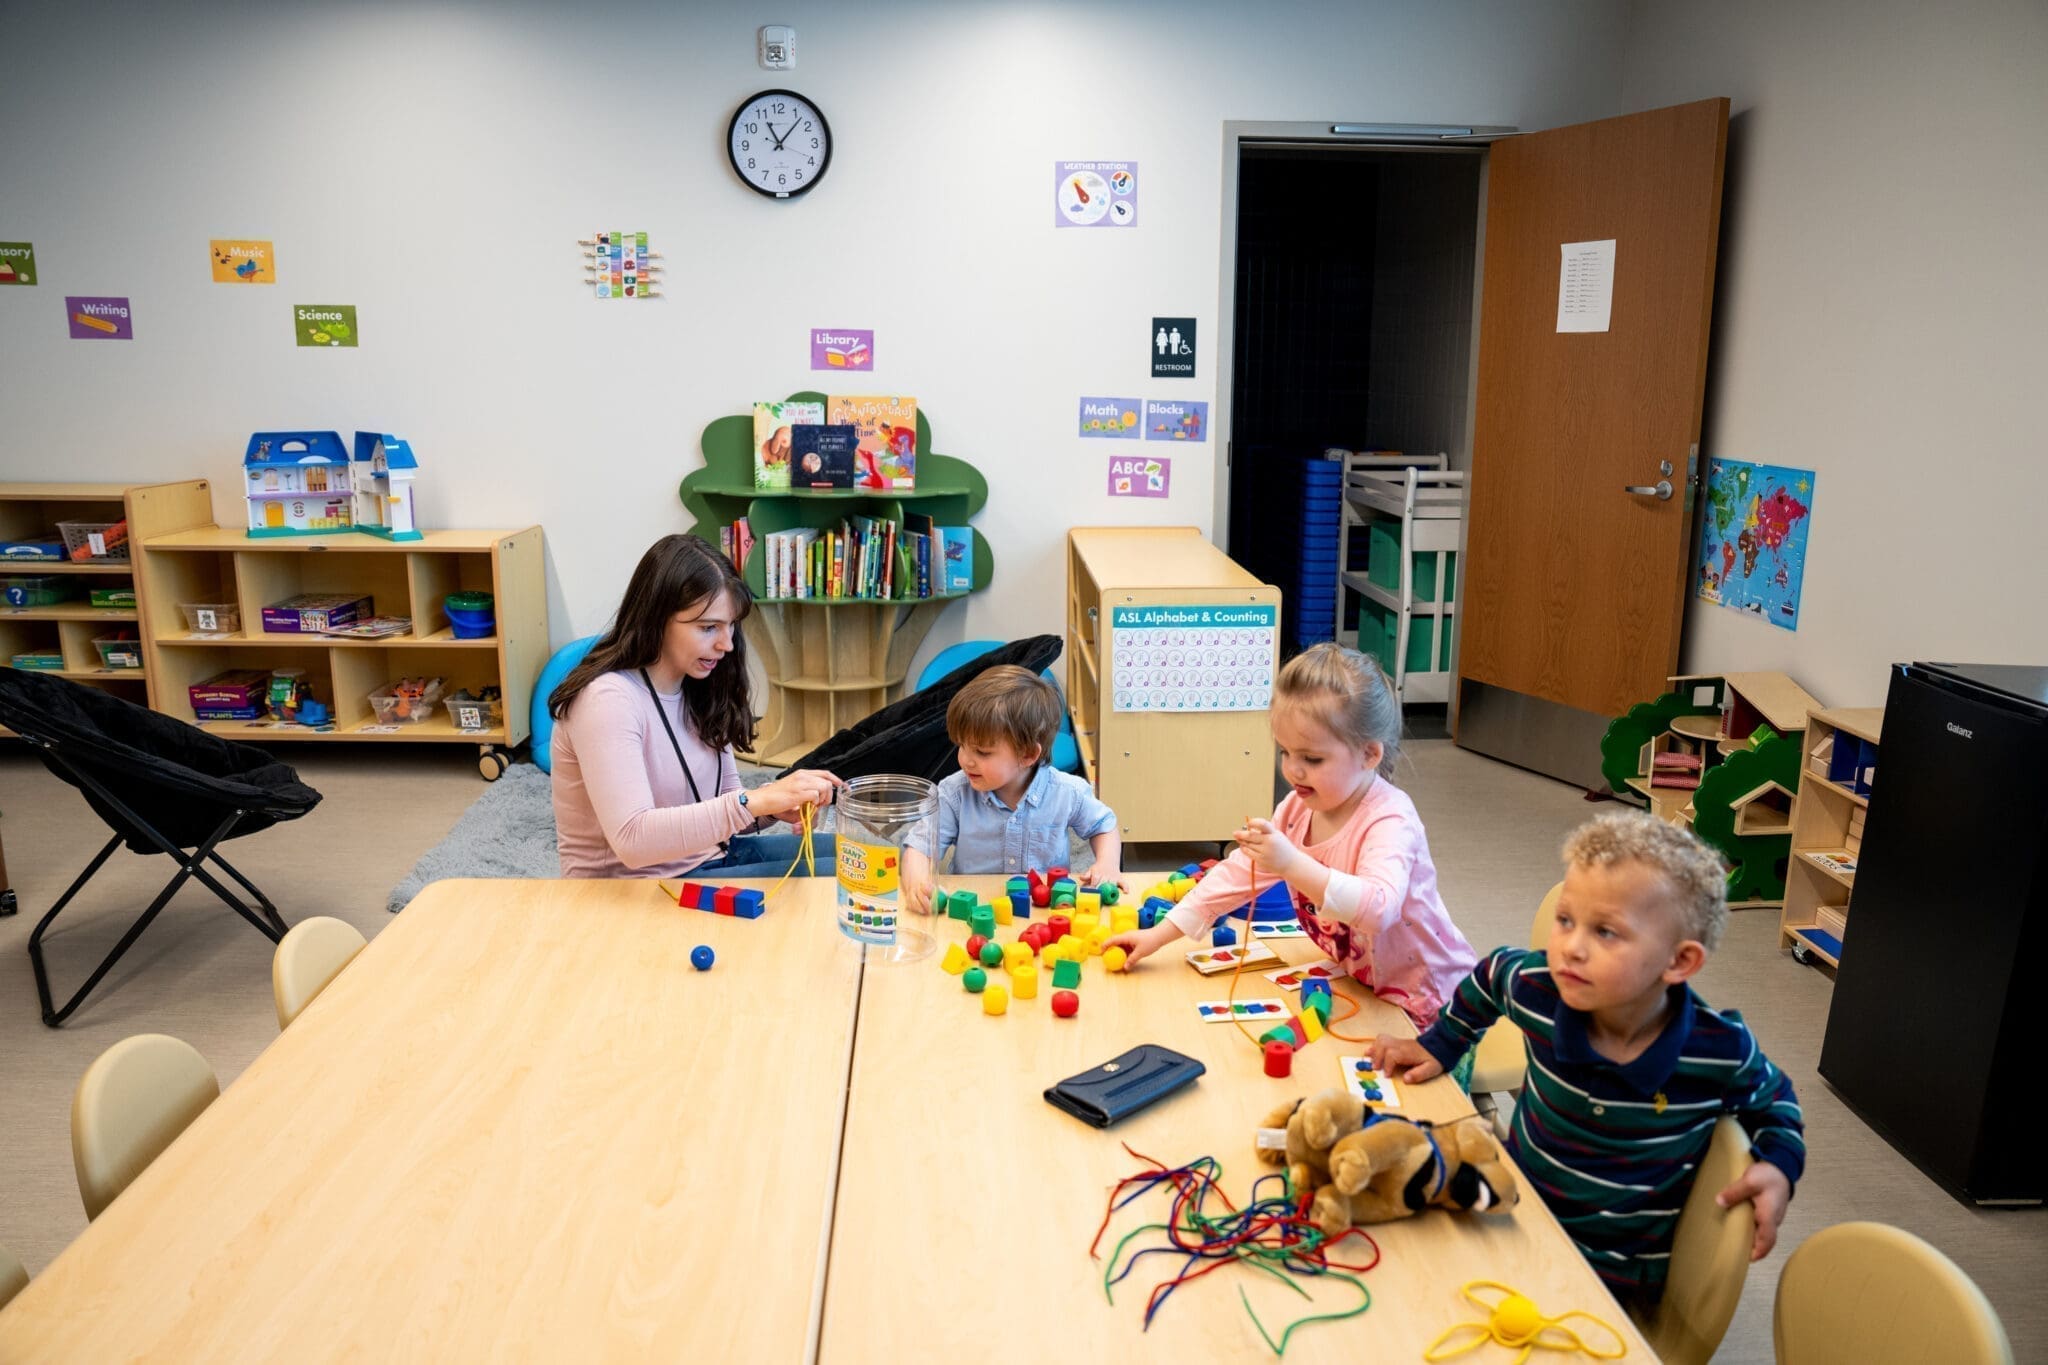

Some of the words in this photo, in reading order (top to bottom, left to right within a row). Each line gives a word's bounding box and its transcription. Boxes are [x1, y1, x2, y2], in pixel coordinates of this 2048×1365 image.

[756, 109, 768, 119] 11
[771, 103, 785, 114] 12
[792, 107, 798, 118] 1
[744, 123, 758, 134] 10
[804, 121, 812, 132] 2
[741, 140, 750, 151] 9
[810, 138, 819, 149] 3
[747, 158, 756, 168] 8
[807, 156, 815, 167] 4
[1064, 162, 1095, 170] WEATHER
[1097, 162, 1128, 170] STATION
[761, 171, 769, 181] 7
[778, 174, 786, 184] 6
[795, 169, 803, 180] 5
[230, 246, 264, 258] Music
[82, 303, 128, 318] Writing
[298, 309, 343, 321] Science
[816, 333, 859, 348] Library
[1084, 403, 1118, 416] Math
[1149, 404, 1184, 415] Blocks
[866, 417, 876, 426] of
[1111, 461, 1144, 475] ABC
[1118, 612, 1142, 623] ASL
[1143, 610, 1199, 626] Alphabet
[1201, 612, 1211, 622] &
[1214, 610, 1268, 625] Counting
